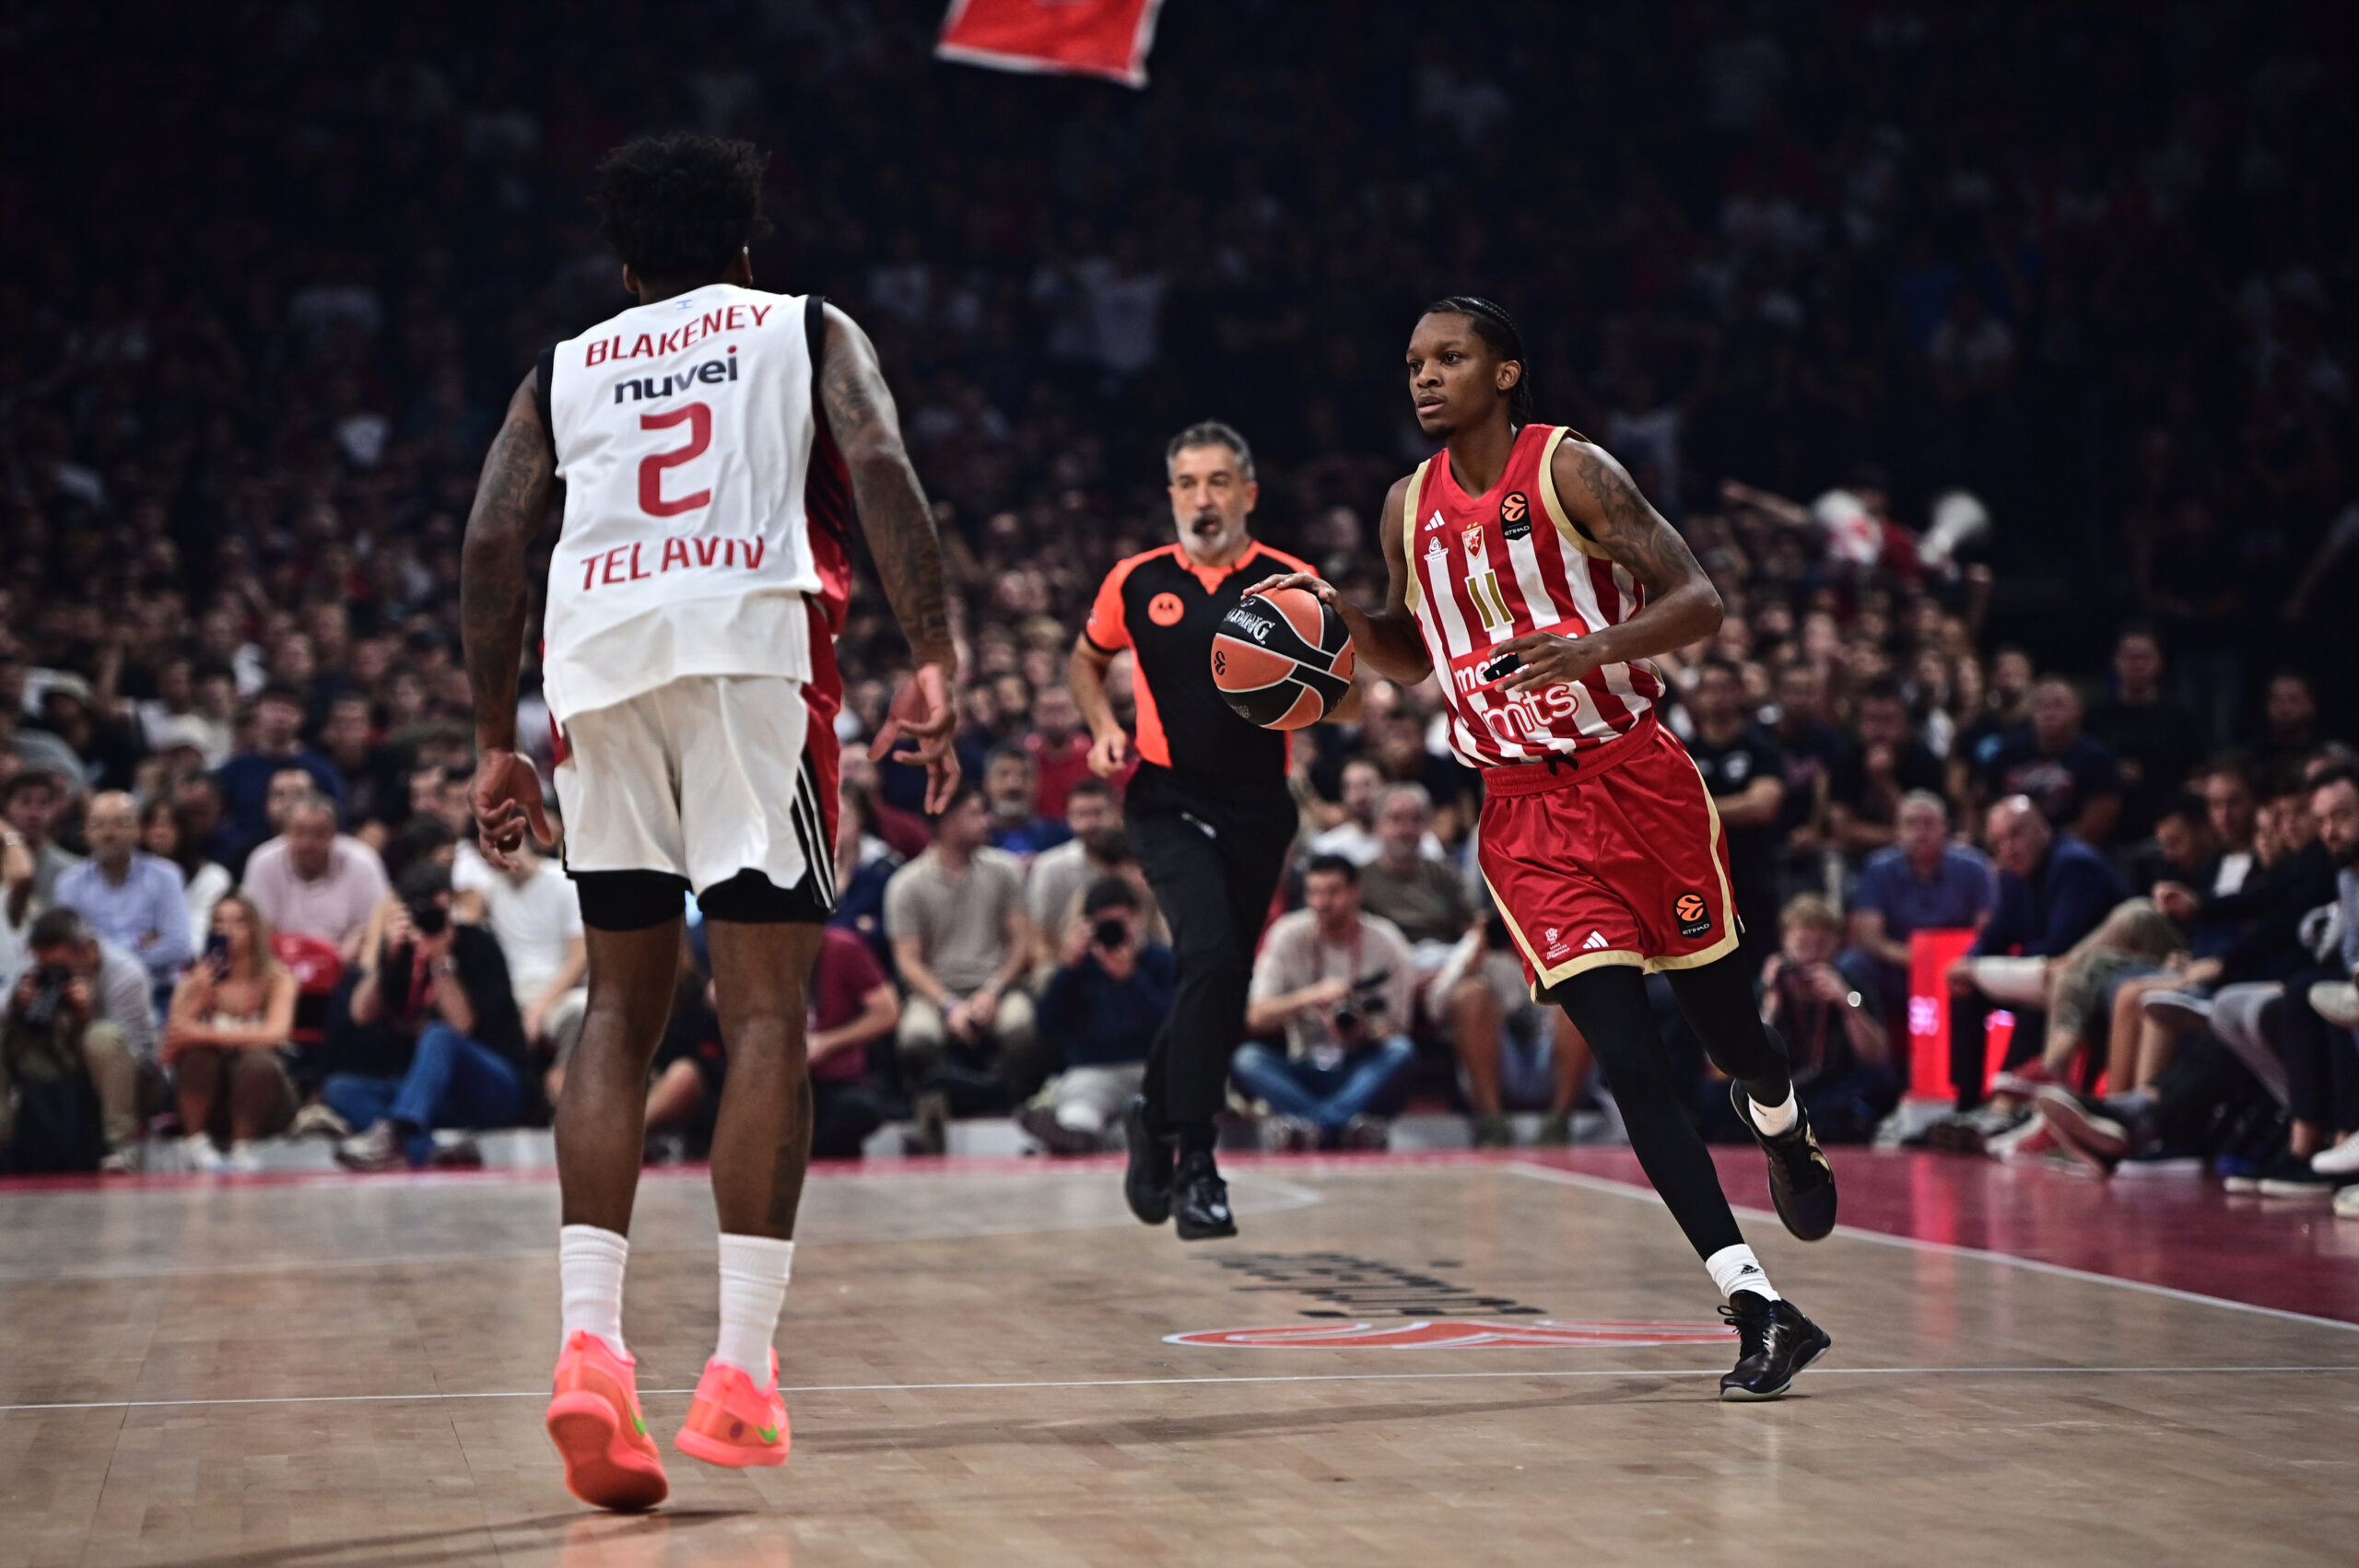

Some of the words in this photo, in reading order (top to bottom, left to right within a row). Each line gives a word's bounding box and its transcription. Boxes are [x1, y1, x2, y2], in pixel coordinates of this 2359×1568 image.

[585, 304, 772, 368] BLAKENEY
[614, 345, 739, 404] nuvei
[638, 401, 711, 518] 2
[1504, 525, 1531, 536] ETIHAD
[580, 541, 651, 591] TEL
[660, 535, 765, 573] AVIV
[1465, 569, 1514, 630] 11
[1483, 684, 1579, 738] mts
[1683, 923, 1710, 935] ETIHAD
